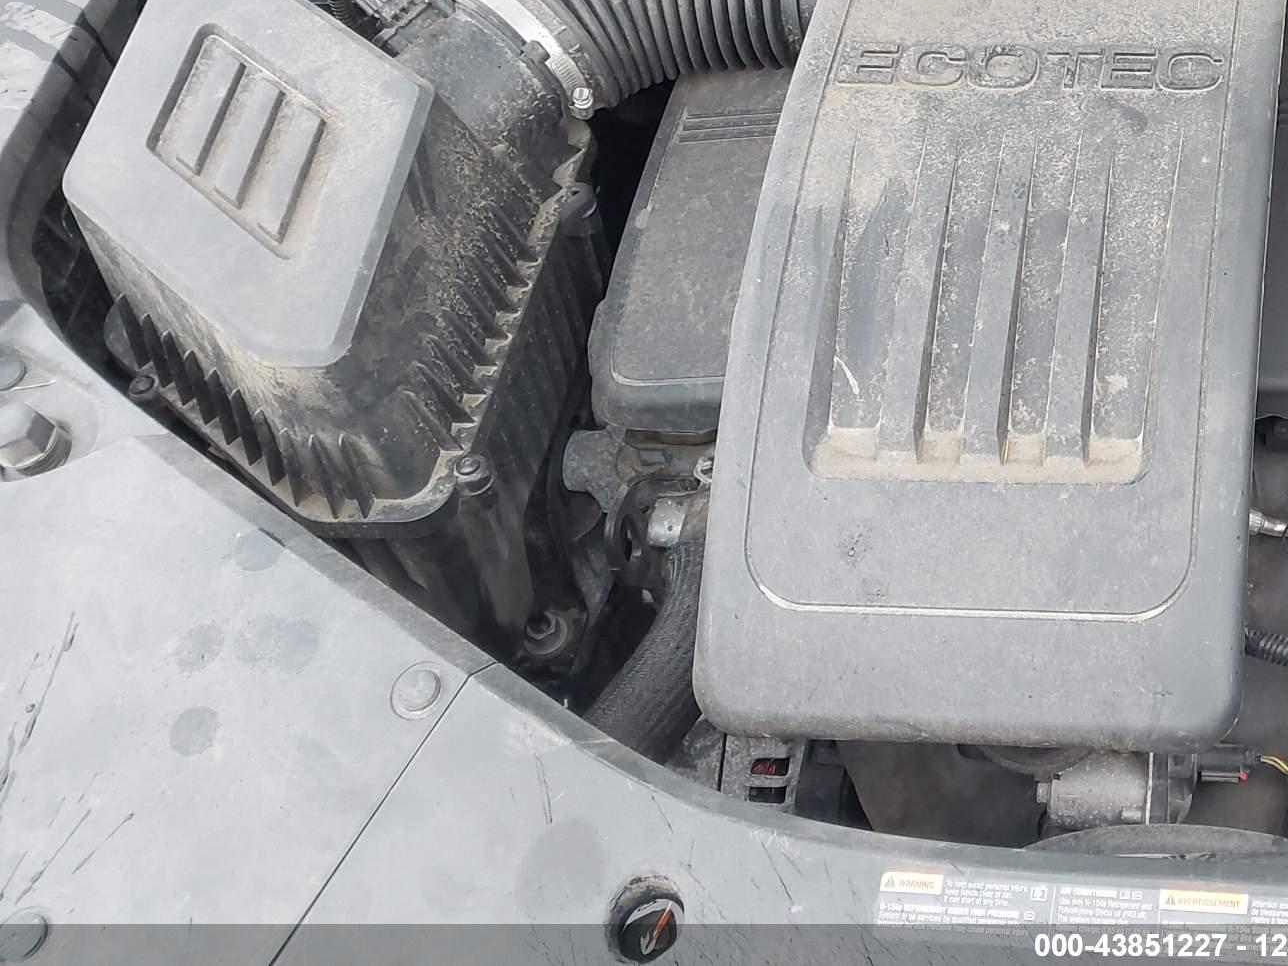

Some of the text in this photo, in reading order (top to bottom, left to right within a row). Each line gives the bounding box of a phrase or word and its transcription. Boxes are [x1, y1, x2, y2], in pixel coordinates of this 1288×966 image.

[836, 44, 1224, 92] ECOTEC
[898, 879, 935, 890] WARNING
[1177, 897, 1241, 909] AVERTISSEMENT
